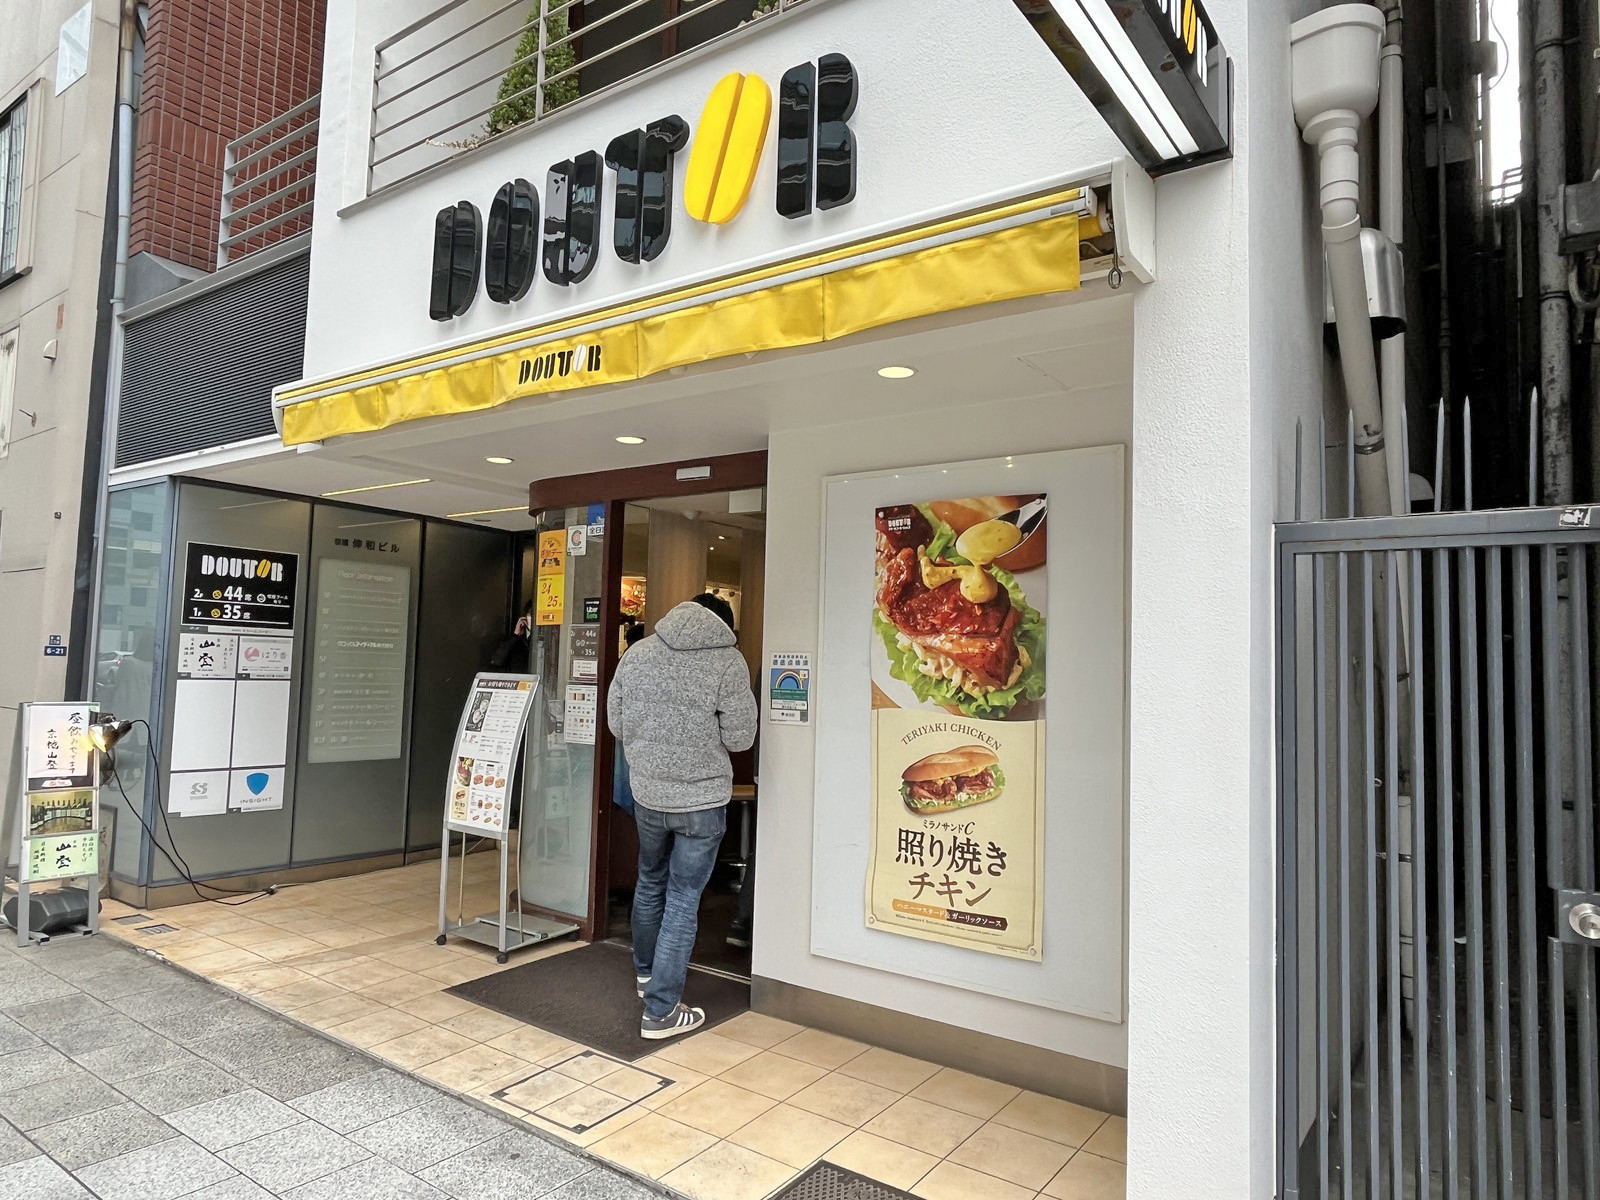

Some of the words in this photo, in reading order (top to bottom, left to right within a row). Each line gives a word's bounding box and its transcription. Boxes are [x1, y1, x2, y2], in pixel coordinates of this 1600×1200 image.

[428, 52, 858, 321] DOUTOR
[518, 344, 601, 385] DOUTOR
[201, 554, 283, 582] DOUTOR
[901, 722, 947, 746] TERIYAKI
[950, 723, 1002, 751] CHICKEN
[240, 797, 273, 805] INSIGHT
[923, 819, 975, 835] ミラノサンドC
[896, 828, 1007, 877] 照り焼き
[908, 872, 992, 908] チキン
